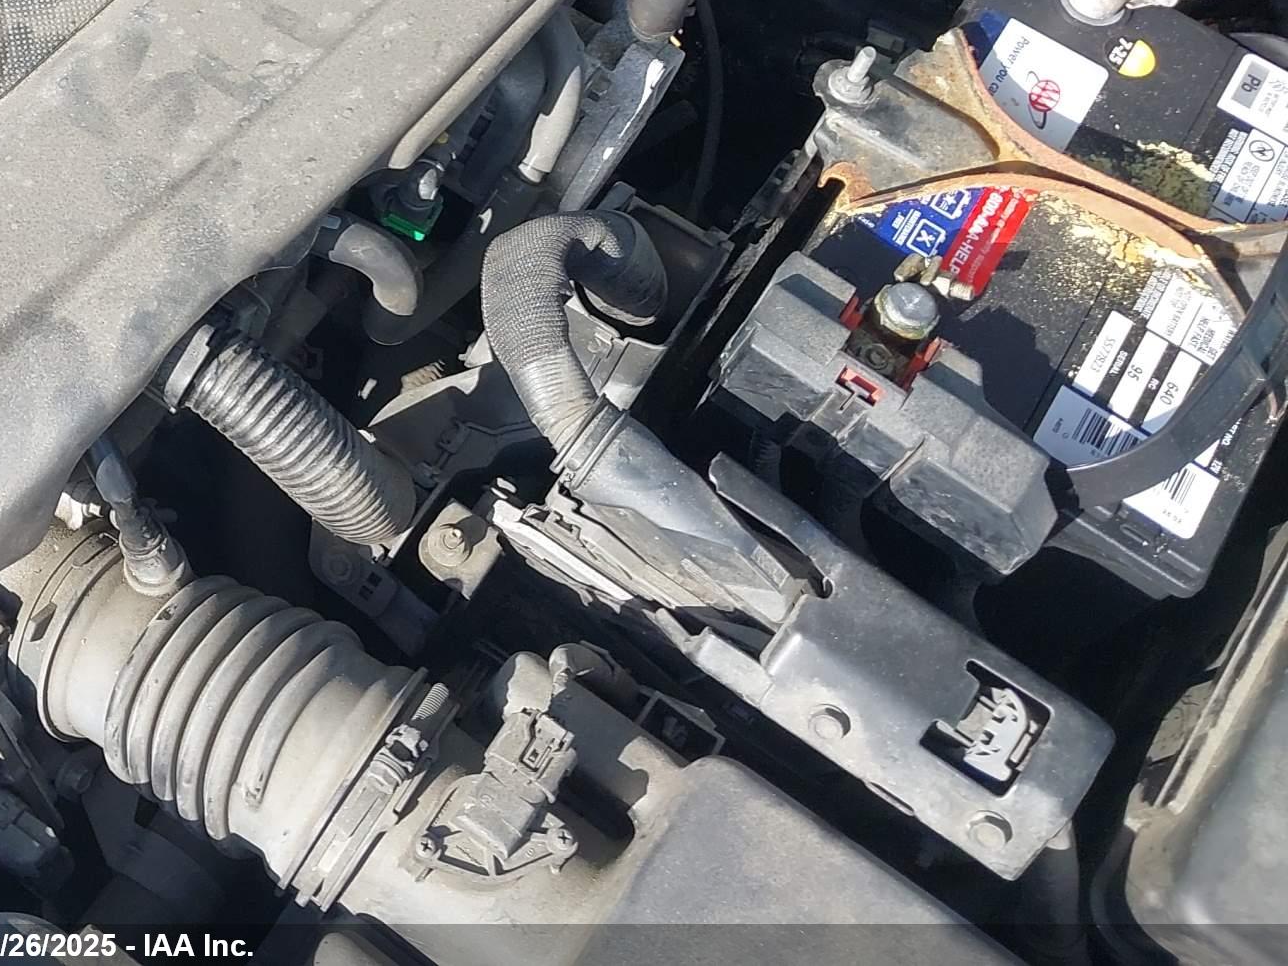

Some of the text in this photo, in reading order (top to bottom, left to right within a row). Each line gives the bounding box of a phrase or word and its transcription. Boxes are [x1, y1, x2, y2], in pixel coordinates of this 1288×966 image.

[1006, 34, 1030, 66] Power
[993, 62, 1011, 83] you
[1240, 72, 1262, 95] Pb
[1108, 349, 1128, 376] SERIAL
[1128, 365, 1143, 380] 95
[1158, 380, 1179, 406] 640
